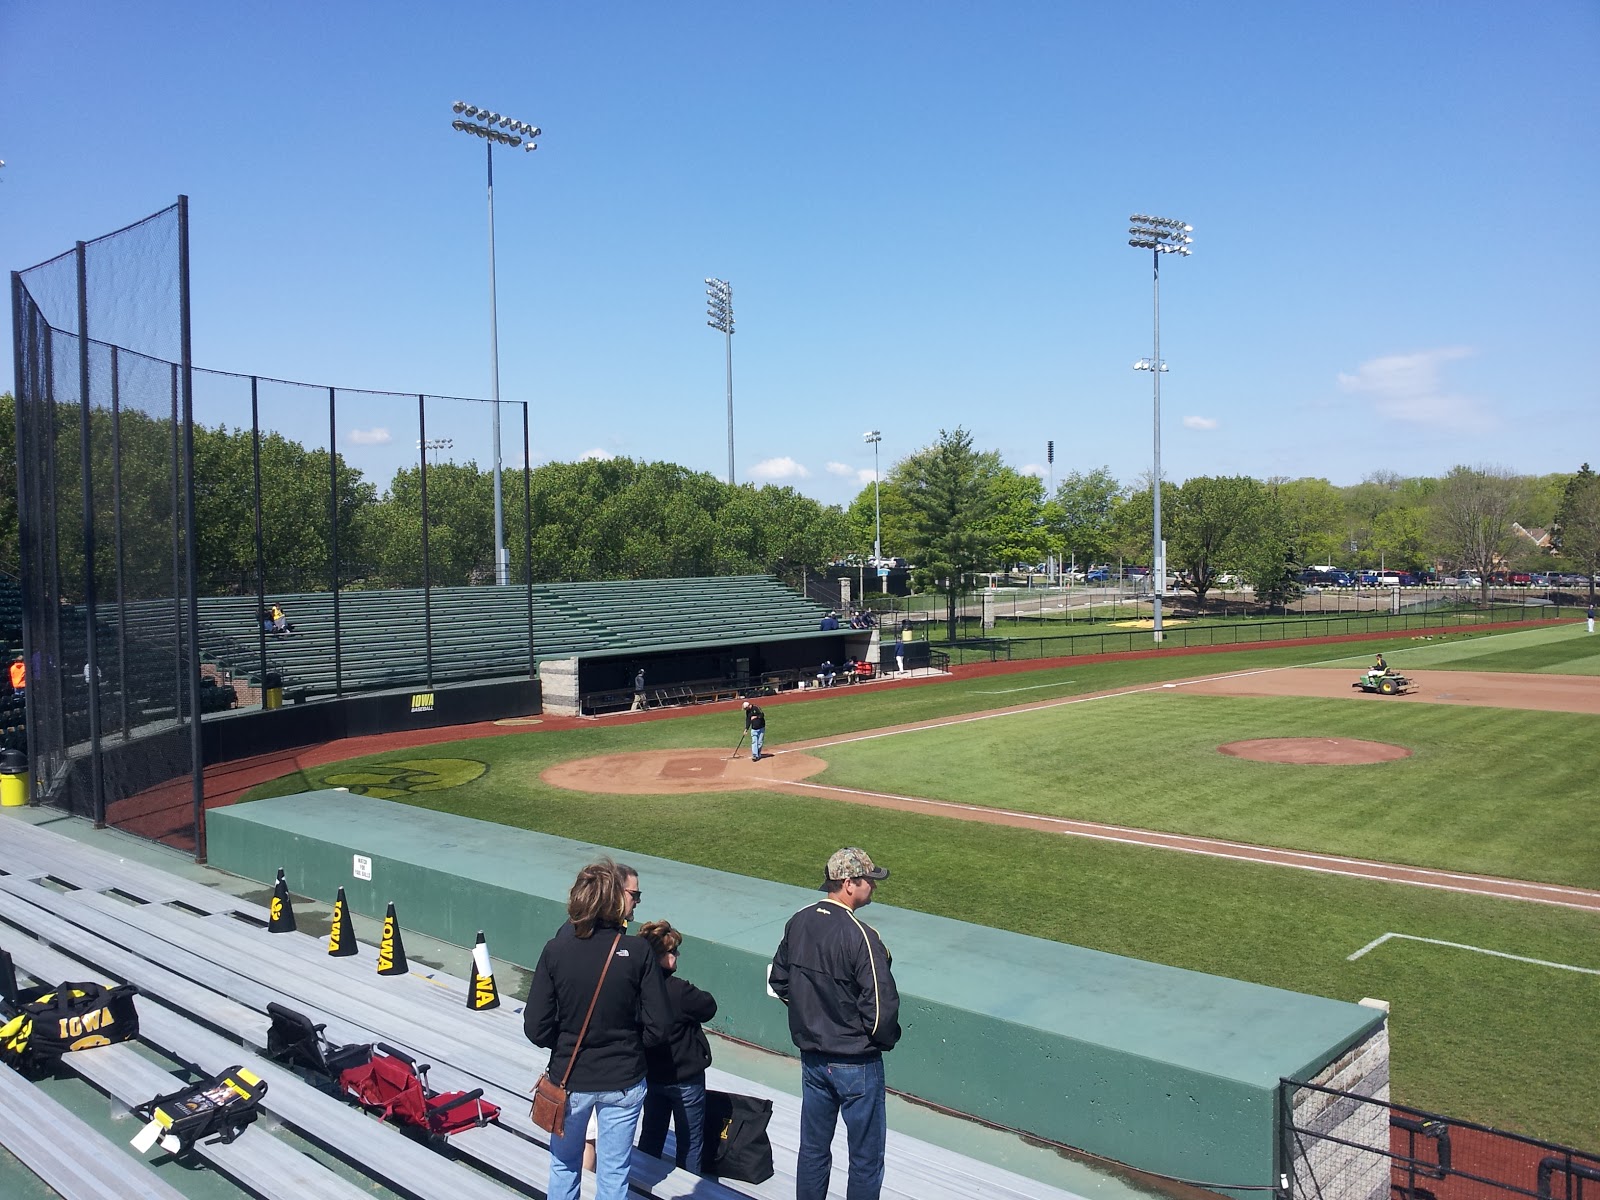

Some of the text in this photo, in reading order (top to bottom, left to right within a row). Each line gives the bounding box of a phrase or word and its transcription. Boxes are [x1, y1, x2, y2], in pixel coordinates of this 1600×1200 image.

[411, 693, 434, 707] IOWA
[328, 901, 342, 952] IOWA
[377, 916, 393, 972] IOWA
[476, 974, 495, 1008] WA
[59, 1006, 115, 1039] IOWA
